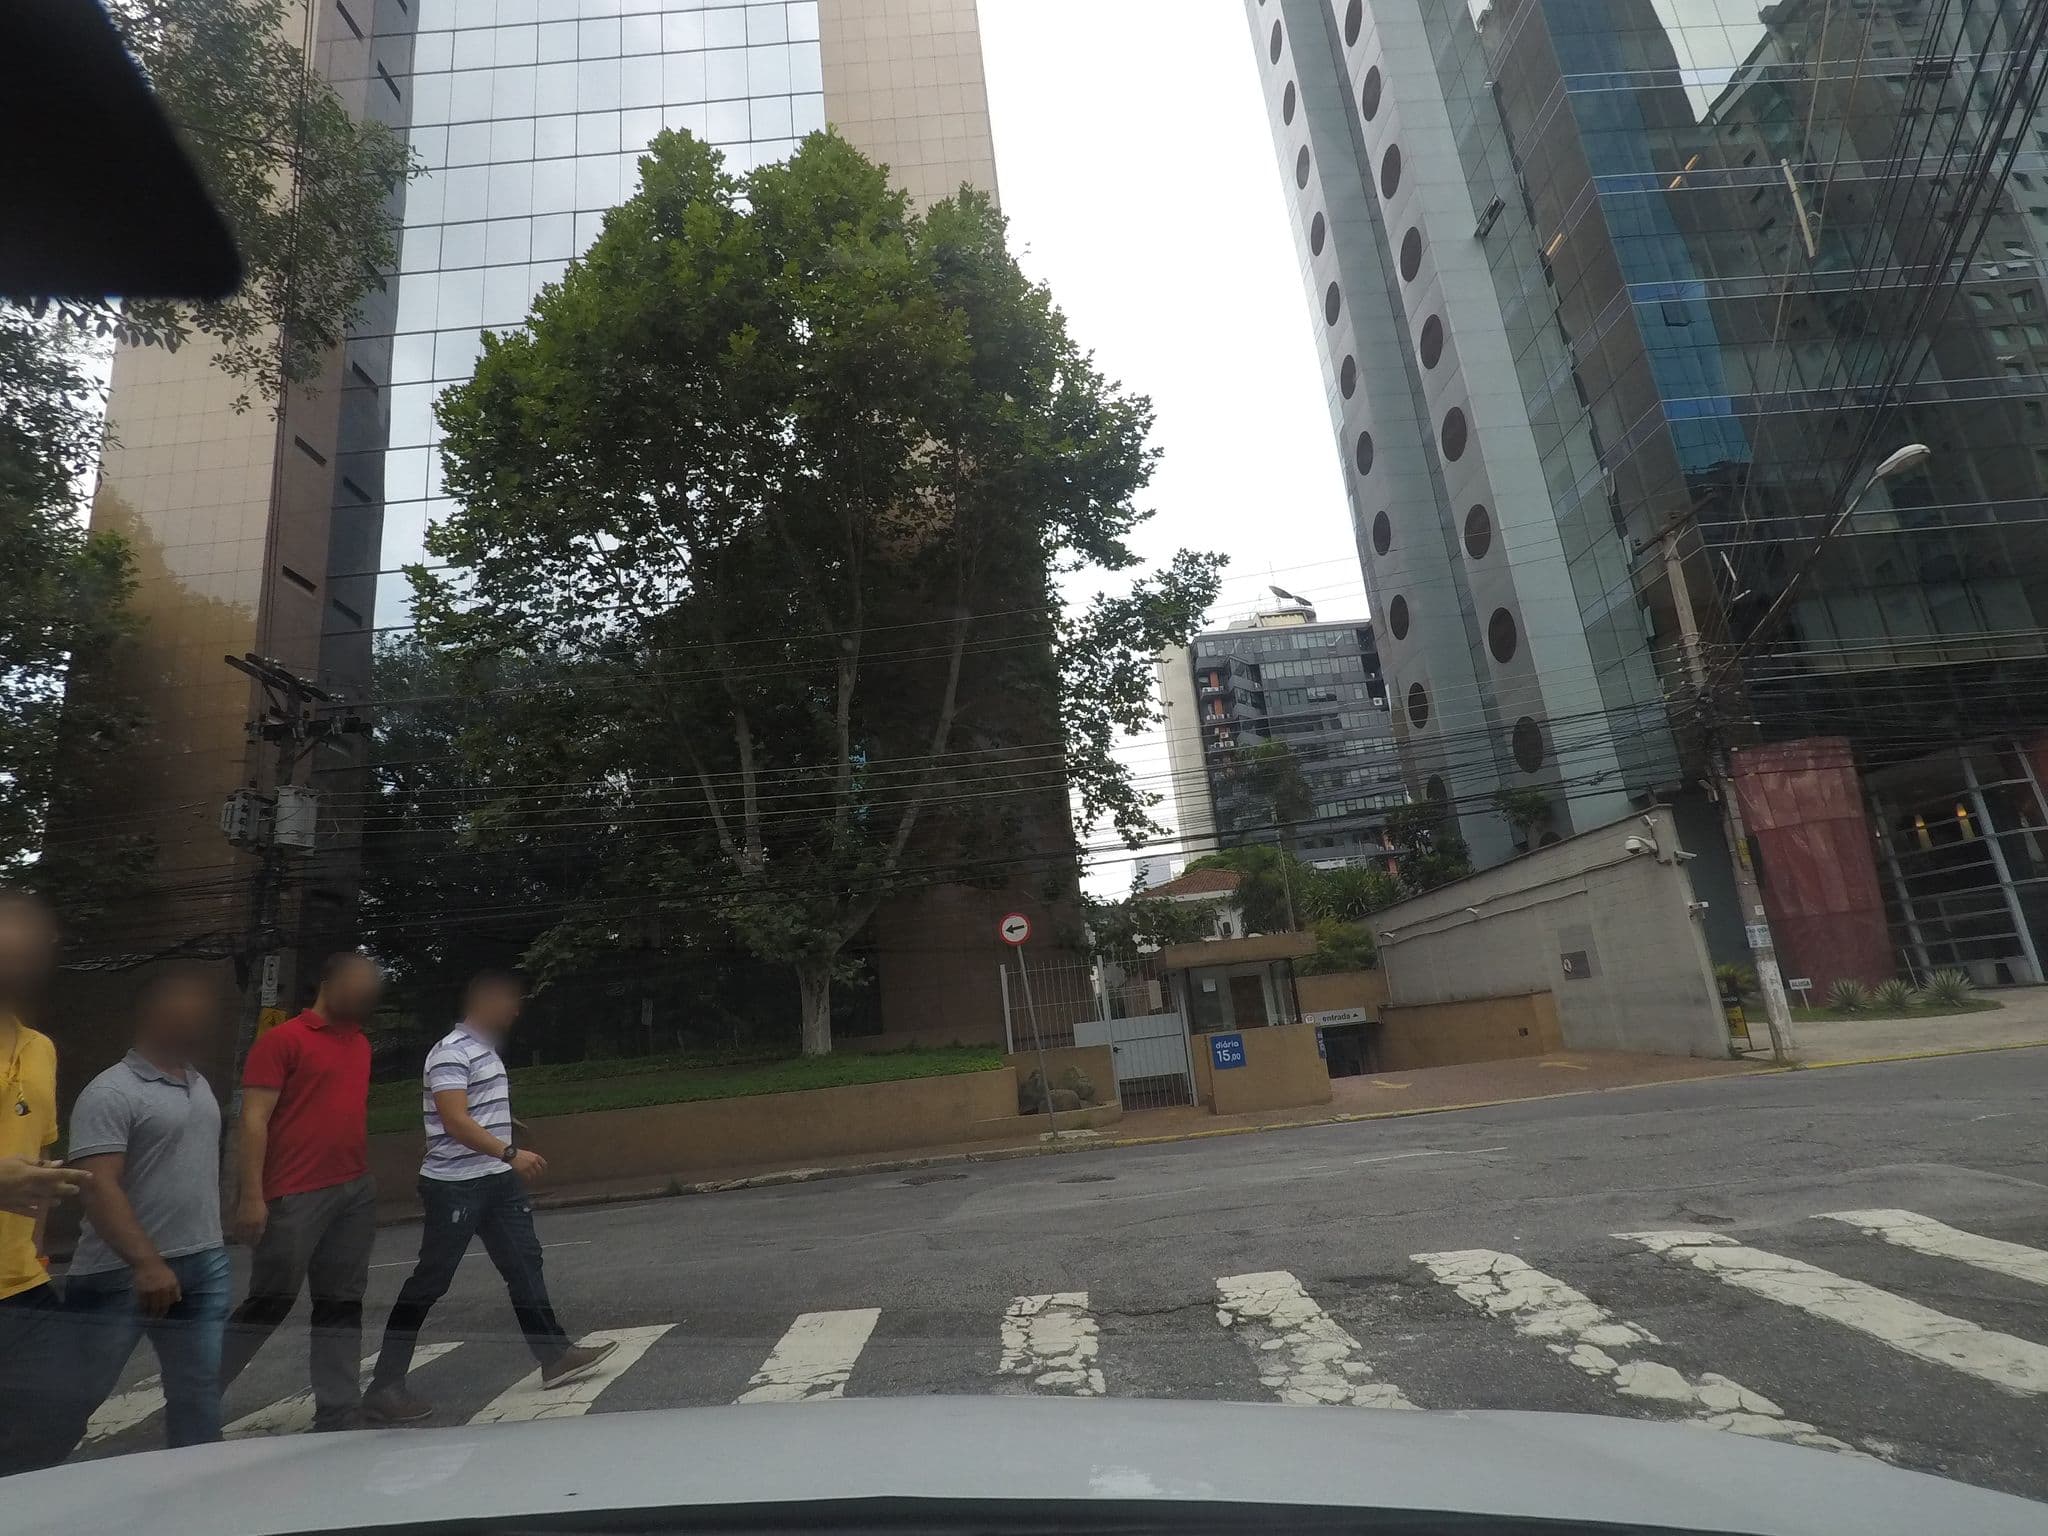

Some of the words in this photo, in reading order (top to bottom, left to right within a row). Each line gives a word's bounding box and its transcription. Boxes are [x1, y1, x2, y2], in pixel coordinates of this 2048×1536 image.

[1322, 1012, 1351, 1022] entrada
[1215, 1039, 1240, 1049] diária
[1216, 1050, 1241, 1063] 15,00
